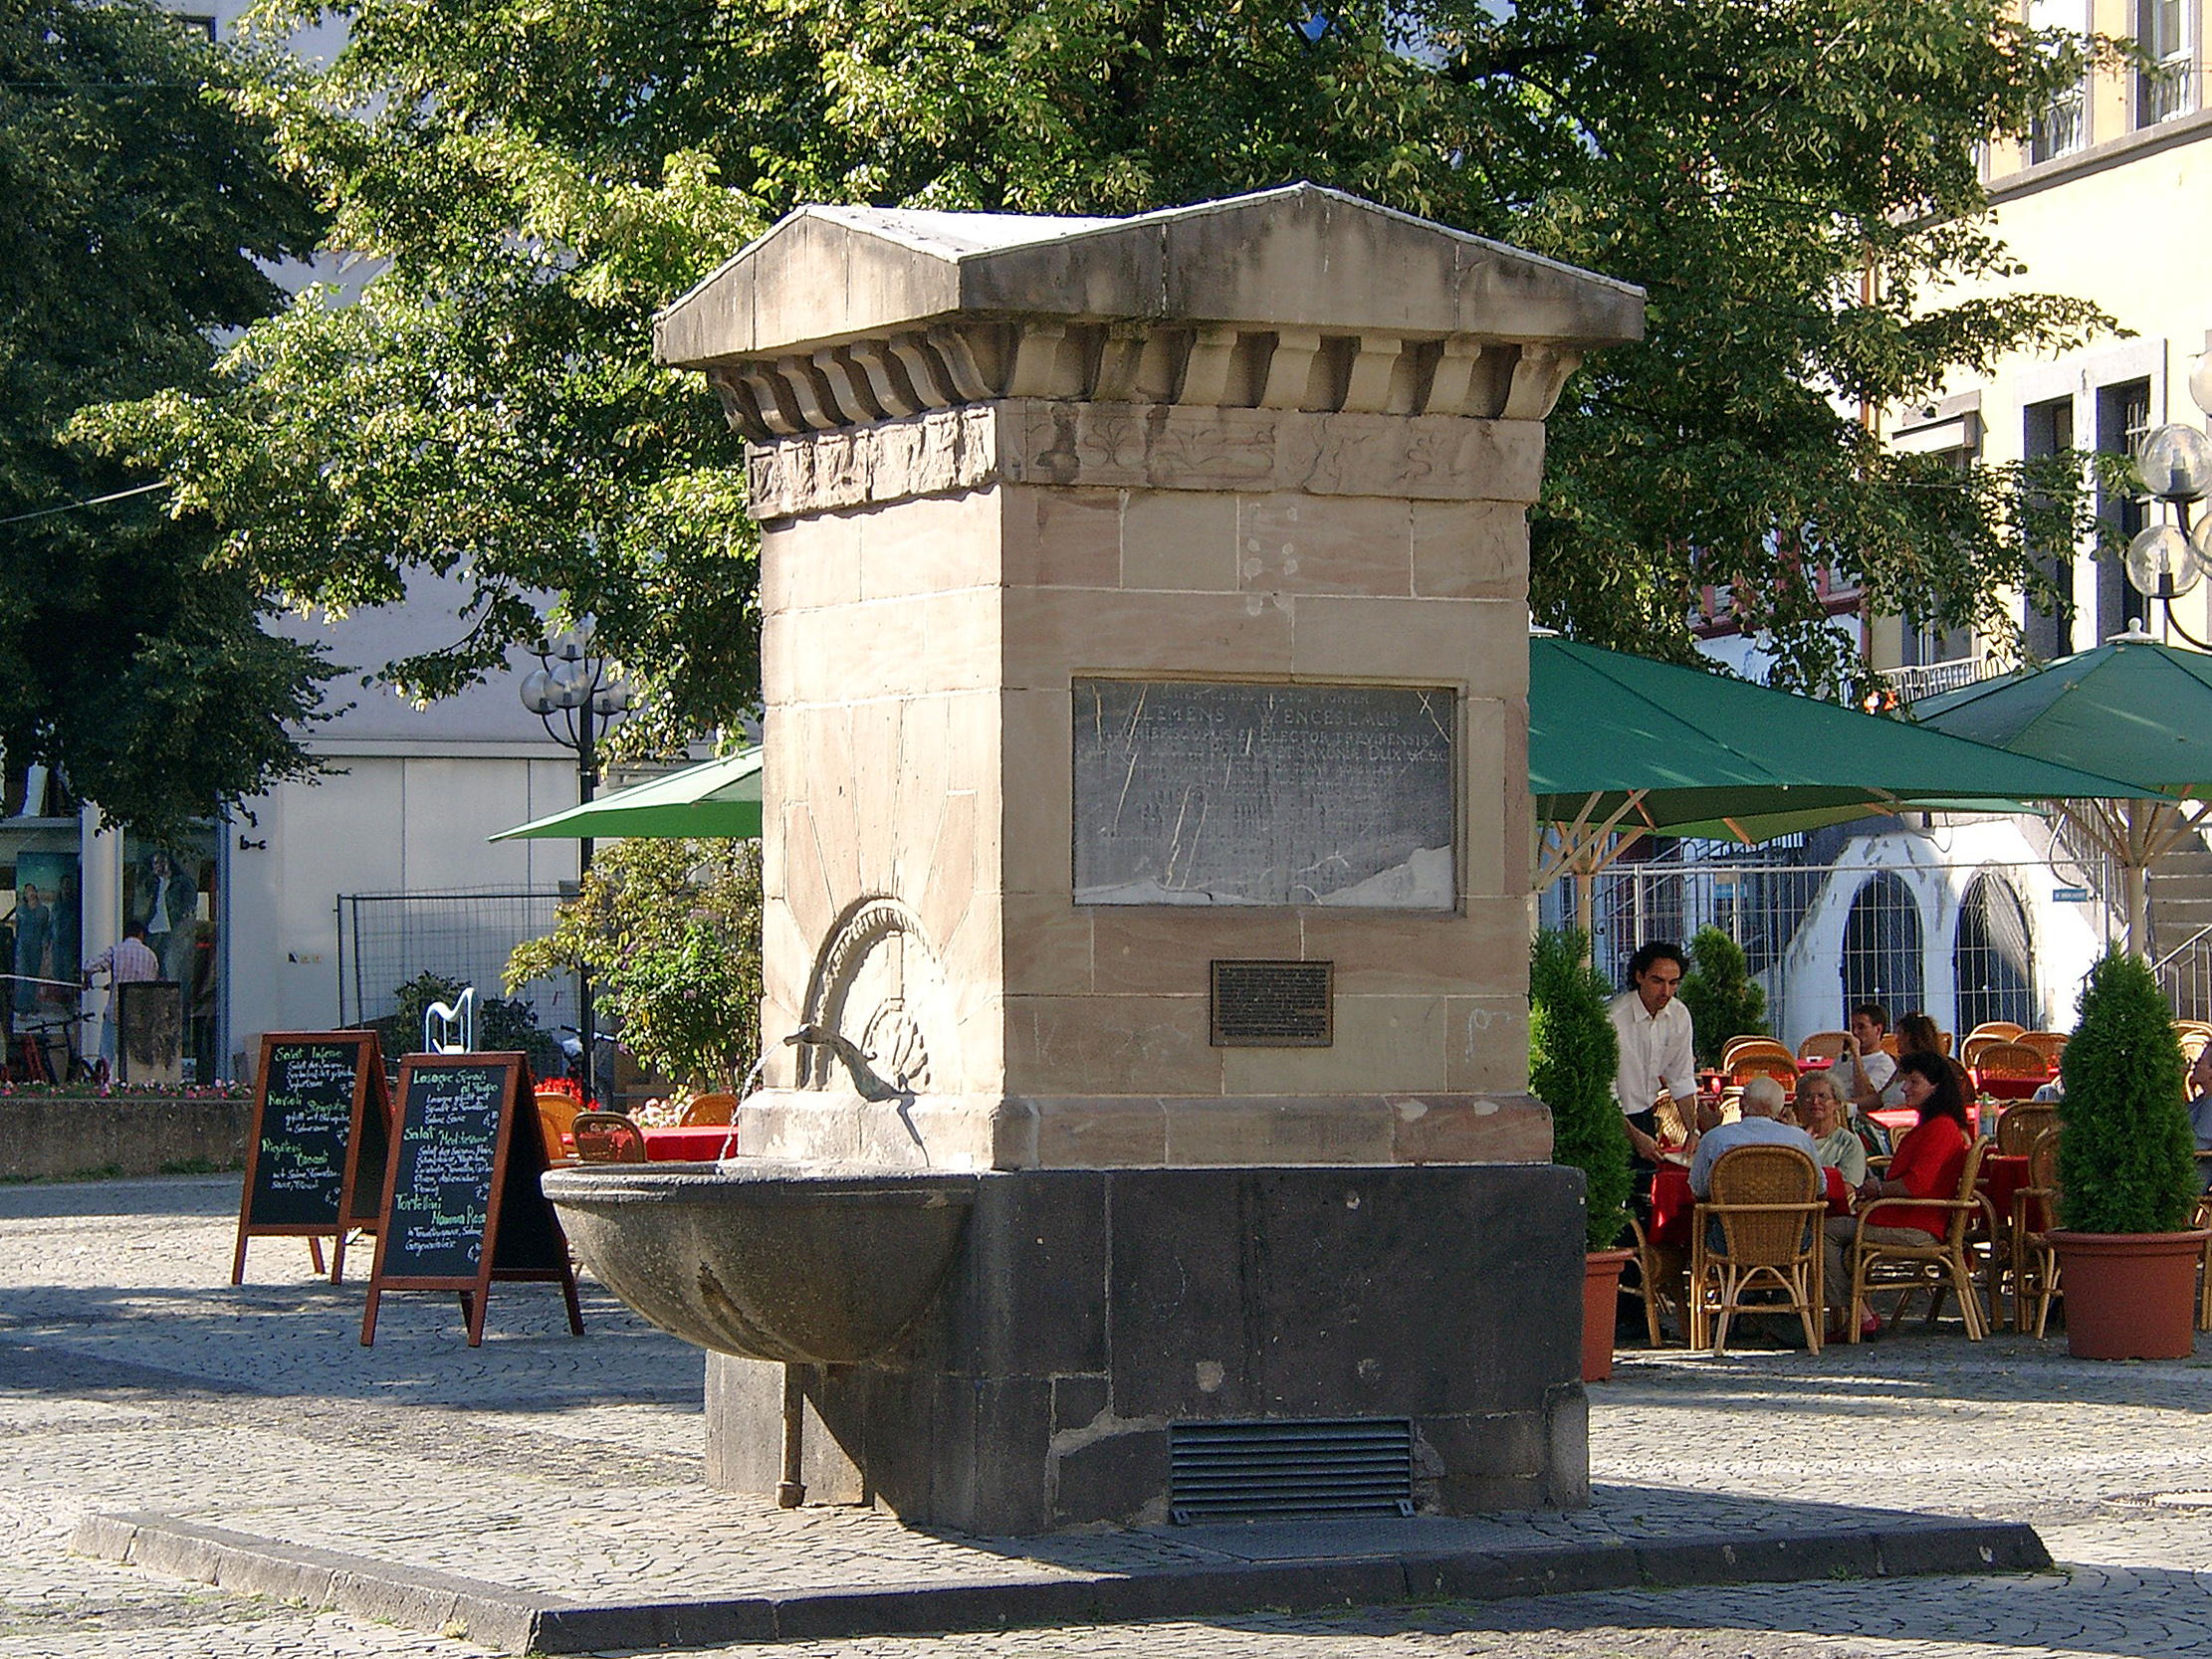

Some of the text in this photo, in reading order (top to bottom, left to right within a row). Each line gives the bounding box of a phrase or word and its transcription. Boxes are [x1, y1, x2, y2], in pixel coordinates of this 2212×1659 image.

[1133, 703, 1226, 725] LEMENS
[239, 834, 267, 850] b-c
[274, 1046, 305, 1062] Salat
[413, 1069, 454, 1092] Lasagne
[268, 1091, 304, 1107] Ravioli
[403, 1126, 436, 1141] Salat
[395, 1192, 443, 1211] Tortellini
